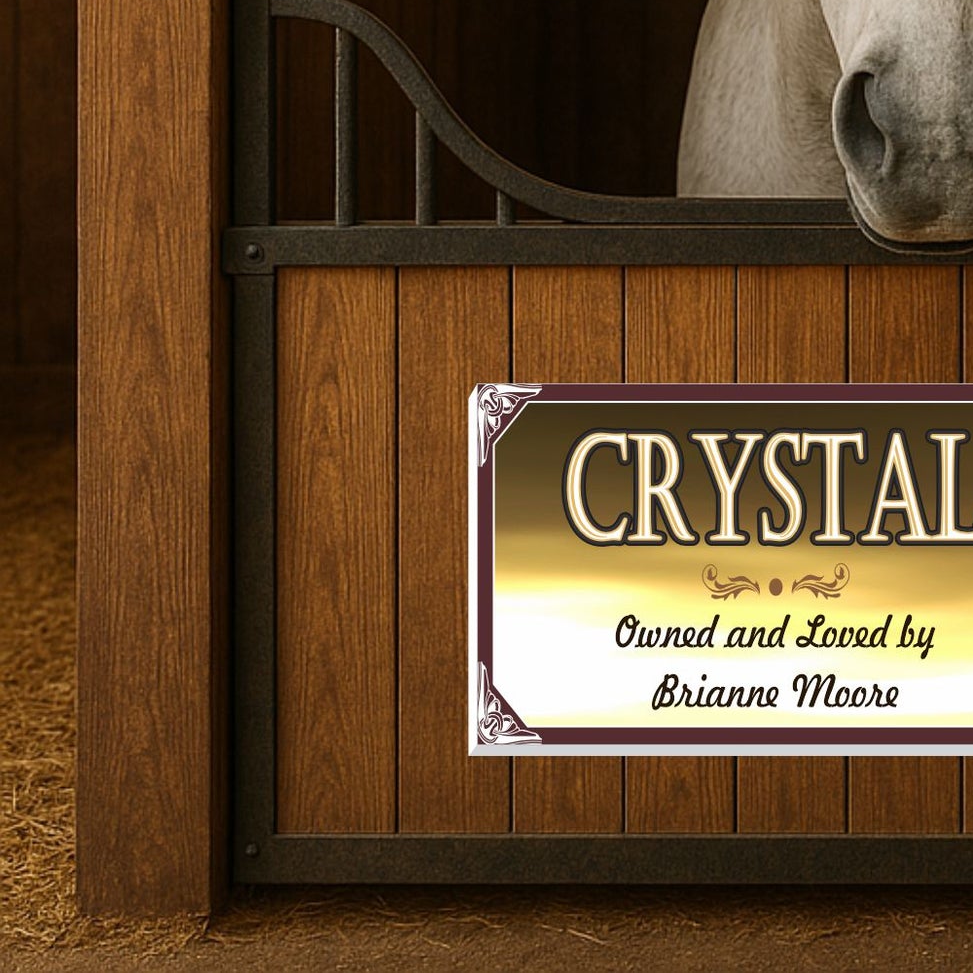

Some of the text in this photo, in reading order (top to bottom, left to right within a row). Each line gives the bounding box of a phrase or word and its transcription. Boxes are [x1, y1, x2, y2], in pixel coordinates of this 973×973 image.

[616, 615, 935, 659] Owned and Loved by
[652, 674, 898, 710] Brianne Moore
